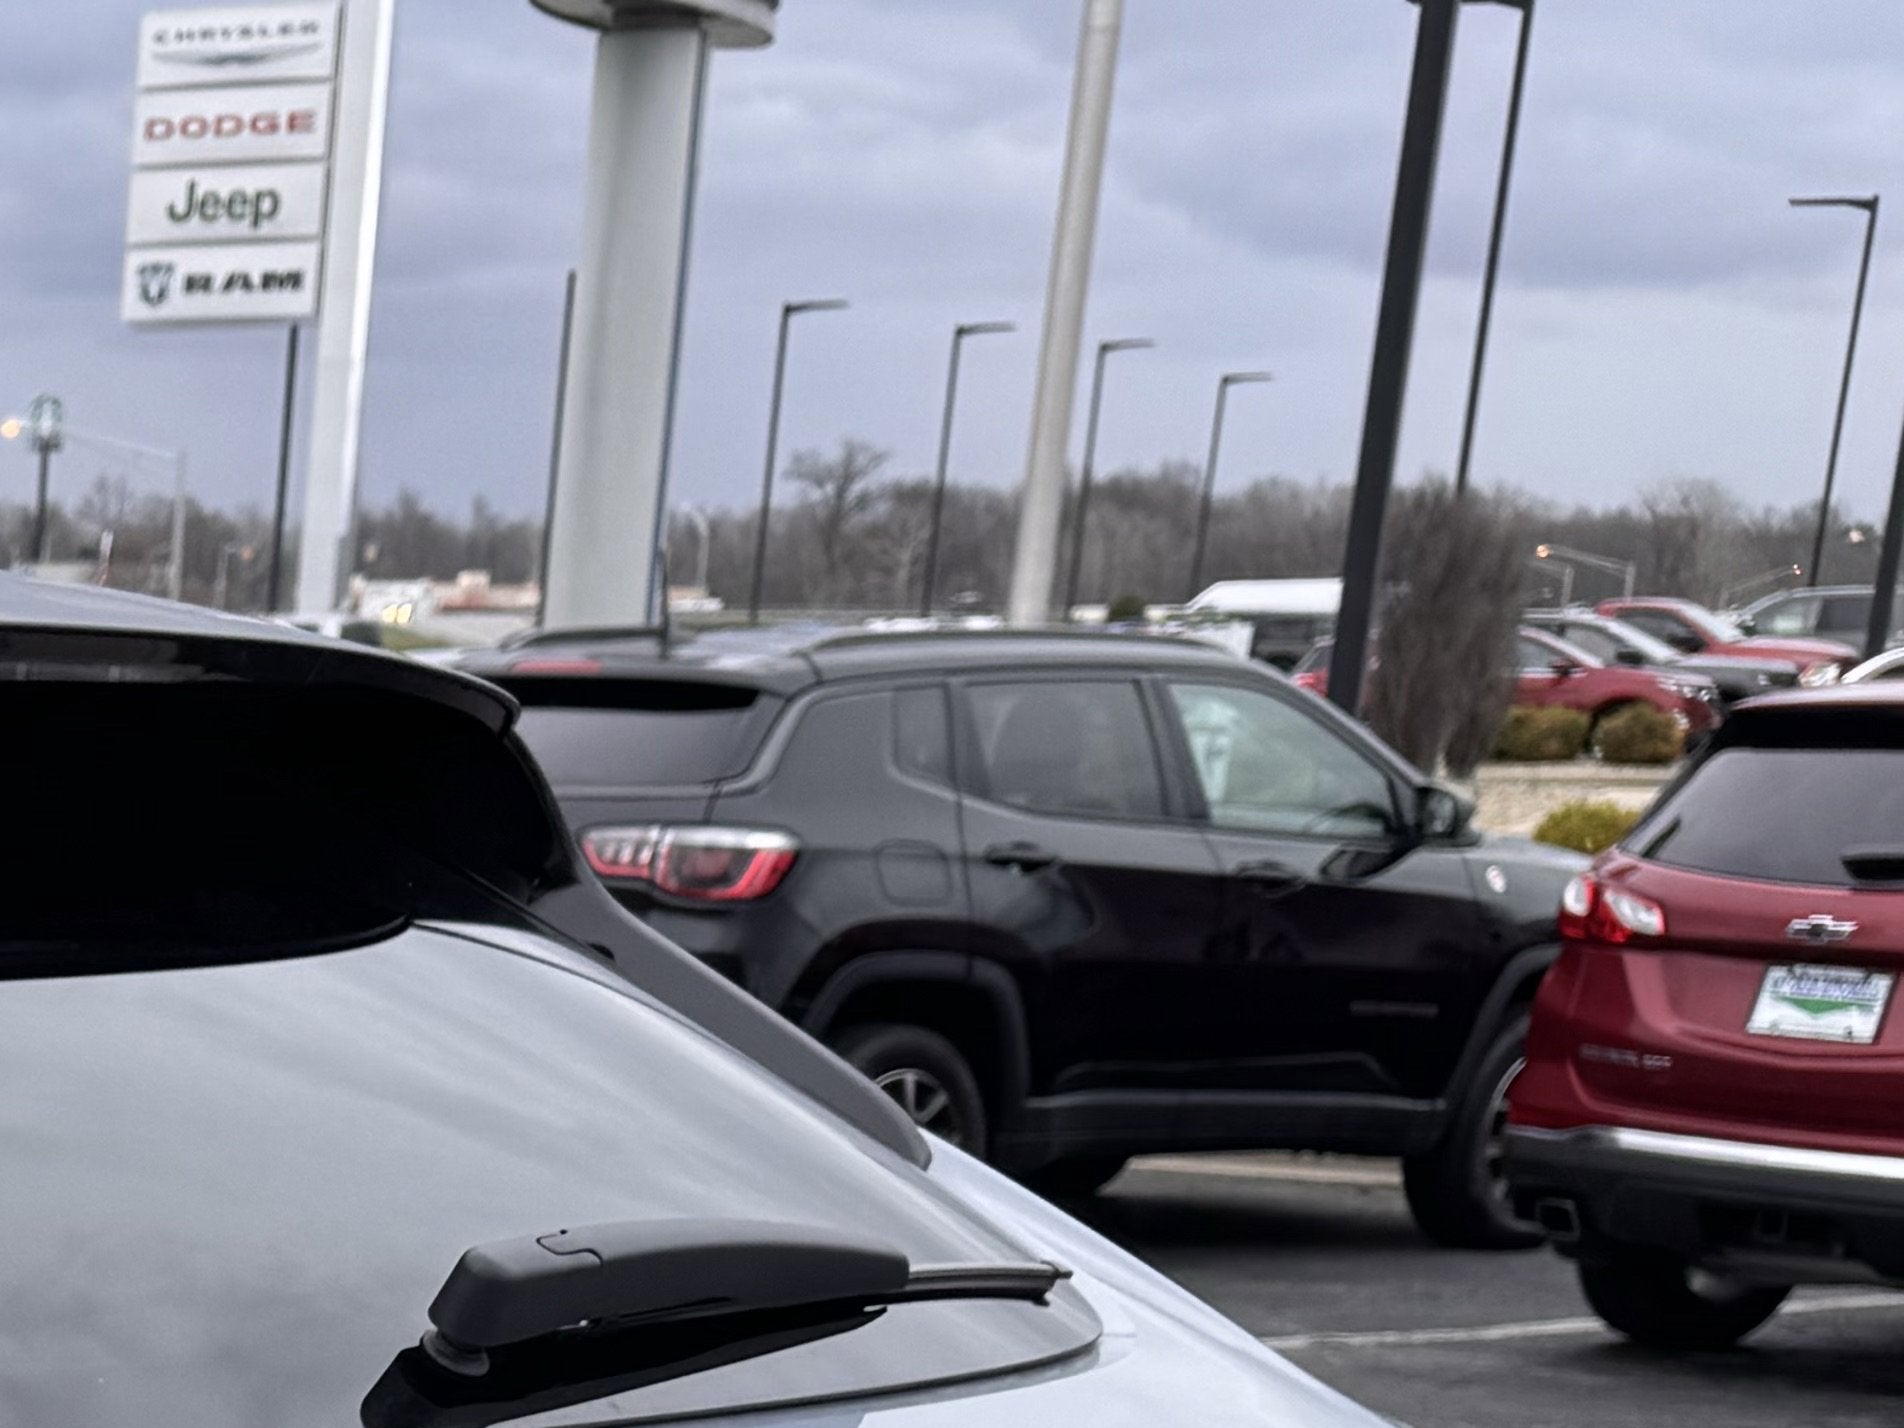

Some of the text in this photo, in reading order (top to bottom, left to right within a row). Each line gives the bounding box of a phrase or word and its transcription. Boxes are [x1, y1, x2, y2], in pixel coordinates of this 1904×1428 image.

[143, 110, 318, 142] DODGE
[165, 180, 282, 229] Jeep
[182, 269, 305, 296] RAM
